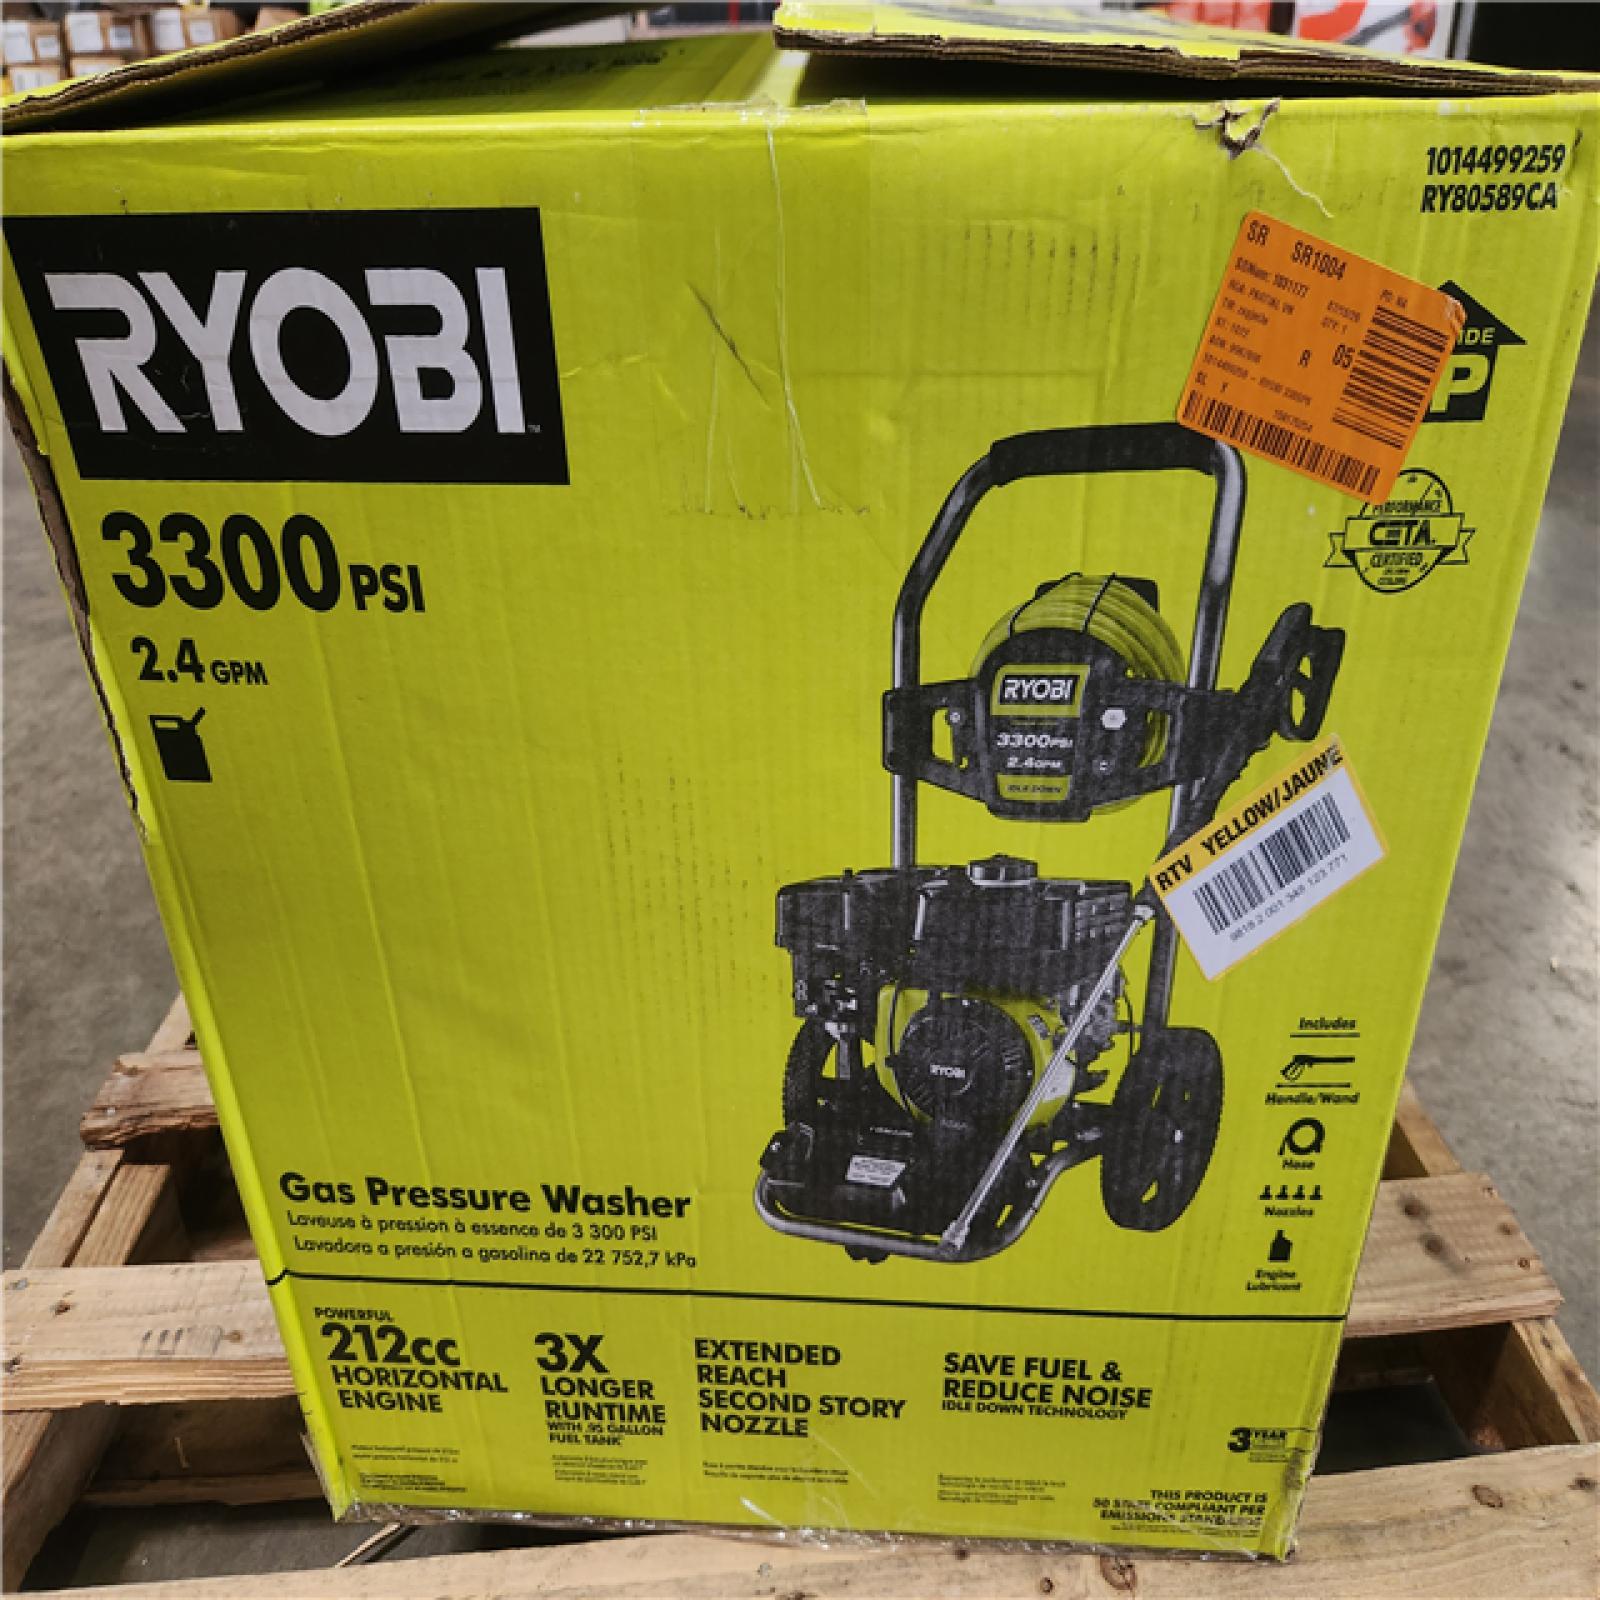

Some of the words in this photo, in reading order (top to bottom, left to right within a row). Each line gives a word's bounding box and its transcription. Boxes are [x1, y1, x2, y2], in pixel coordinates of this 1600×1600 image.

[1426, 144, 1566, 176] 1014499259
[1421, 181, 1559, 214] RY80589CA
[1246, 219, 1270, 246] SR
[1291, 239, 1346, 281] SR1004
[44, 266, 527, 437] RYOBI
[1333, 344, 1354, 369] 05
[1429, 354, 1488, 412] P
[101, 510, 341, 611] 3300
[348, 564, 426, 613] PSI
[130, 636, 207, 683] 2.4
[210, 660, 269, 686] GPM
[1003, 678, 1073, 700] RYOBI
[1155, 854, 1194, 891] RTV
[1200, 744, 1344, 856] YELLOW/JAUNE
[1298, 1016, 1357, 1030] Includes
[1264, 1091, 1361, 1106] Handle/Wand
[1281, 1159, 1316, 1170] Hose
[279, 1171, 356, 1206] Gas
[364, 1176, 531, 1212] Pressure
[540, 1183, 691, 1219] Washer
[1264, 1206, 1315, 1217] Nozzles
[287, 1210, 355, 1229] Laveuse
[377, 1214, 449, 1236] pression
[471, 1223, 539, 1238] essence
[544, 1223, 567, 1239] de
[571, 1224, 583, 1240] 3
[589, 1223, 626, 1242] 300
[631, 1224, 658, 1241] PSI
[294, 1235, 374, 1256] Lavadora
[378, 1243, 388, 1256] a
[394, 1238, 457, 1261] presión
[462, 1247, 473, 1260] a
[478, 1243, 550, 1265] gasolina
[555, 1247, 579, 1263] de
[582, 1248, 606, 1265] 22
[612, 1247, 660, 1269] 752,7
[664, 1249, 697, 1269] kPa
[1246, 1282, 1303, 1292] Lubricant
[1254, 1268, 1297, 1281] Engine
[314, 1306, 394, 1322] POWERFUL
[321, 1322, 461, 1366] 212cc
[534, 1331, 609, 1374] 3X
[694, 1337, 842, 1366] EXTENDED
[331, 1364, 509, 1393] HORIZONTAL
[697, 1364, 787, 1388] REACH
[943, 1351, 1015, 1376] SAVE
[1025, 1356, 1092, 1381] FUEL
[1100, 1360, 1123, 1382] &
[337, 1389, 444, 1413] ENGINE
[540, 1375, 656, 1401] LONGER
[942, 1378, 1053, 1404] REDUCE
[1061, 1385, 1153, 1409] NOISE
[544, 1400, 666, 1424] RUNTIME
[698, 1388, 811, 1414] SECOND
[818, 1395, 907, 1419] STORY
[941, 1400, 971, 1412] IDLE
[975, 1402, 1024, 1415] DOWN
[1028, 1405, 1128, 1421] TECHNOLOGY
[547, 1421, 583, 1433] WITH
[607, 1424, 664, 1436] GALLON
[701, 1412, 809, 1438] NOZZLE
[548, 1433, 581, 1444] FUEL
[1228, 1427, 1250, 1453] 3
[1151, 1490, 1181, 1501] THIS
[1184, 1490, 1252, 1504] PRODUCT
